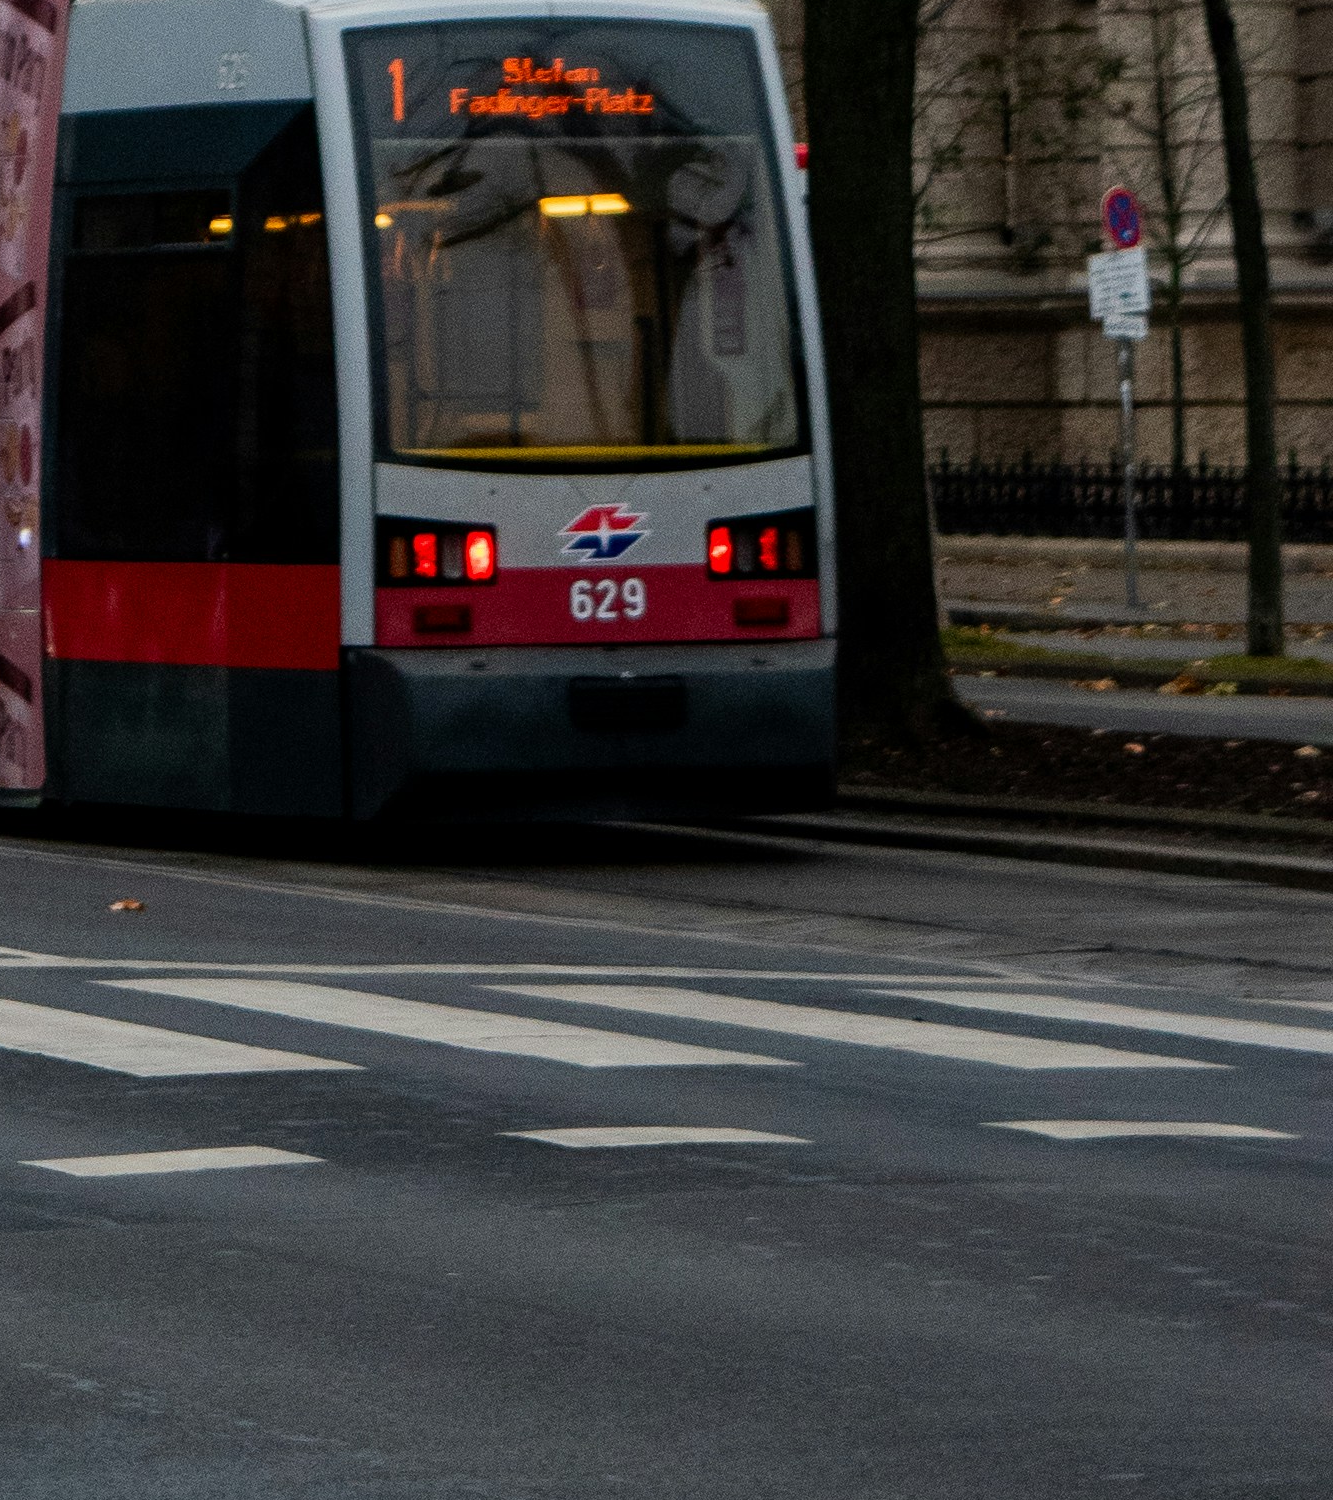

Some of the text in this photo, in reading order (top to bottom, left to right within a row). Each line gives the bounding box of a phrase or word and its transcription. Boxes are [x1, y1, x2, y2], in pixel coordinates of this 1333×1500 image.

[502, 57, 600, 83] Stefan
[386, 58, 407, 123] 1
[449, 87, 654, 120] Fadinger-Platz
[569, 577, 647, 622] 629
